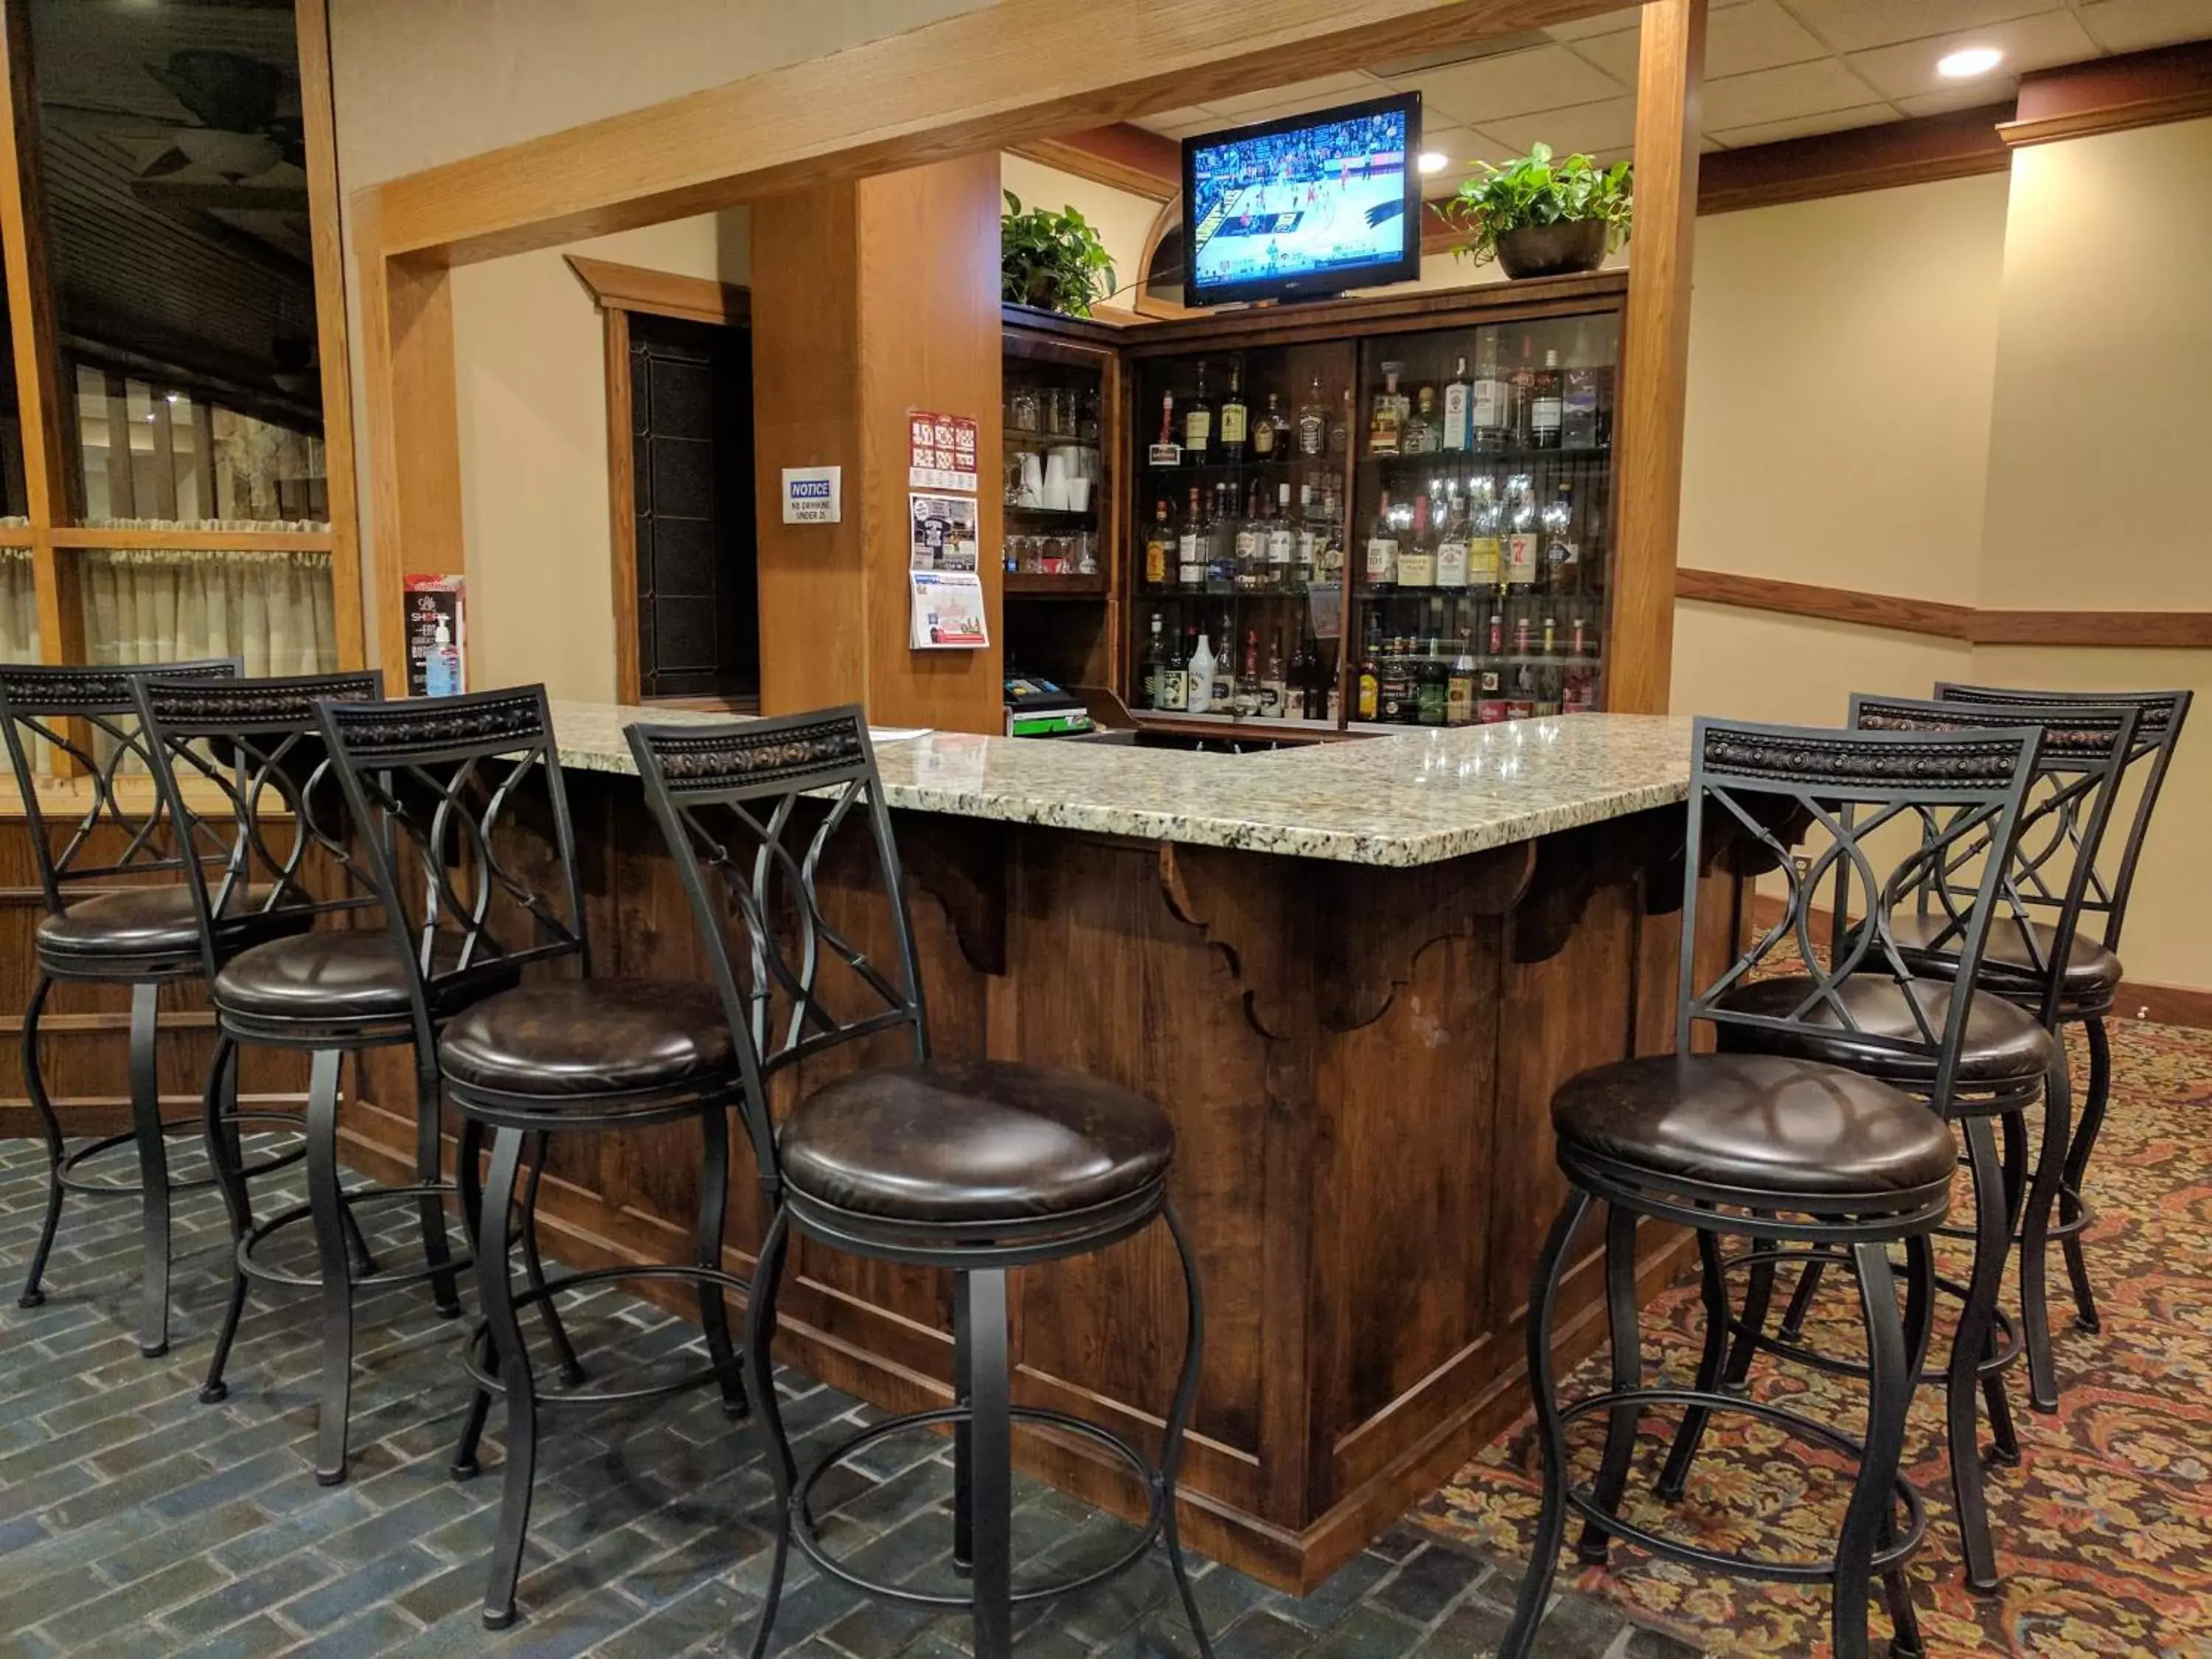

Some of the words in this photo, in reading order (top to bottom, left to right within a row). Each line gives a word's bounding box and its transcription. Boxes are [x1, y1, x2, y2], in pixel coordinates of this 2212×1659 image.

[793, 483, 828, 496] NOTICE
[791, 501, 800, 509] NO
[796, 511, 817, 520] UNDER
